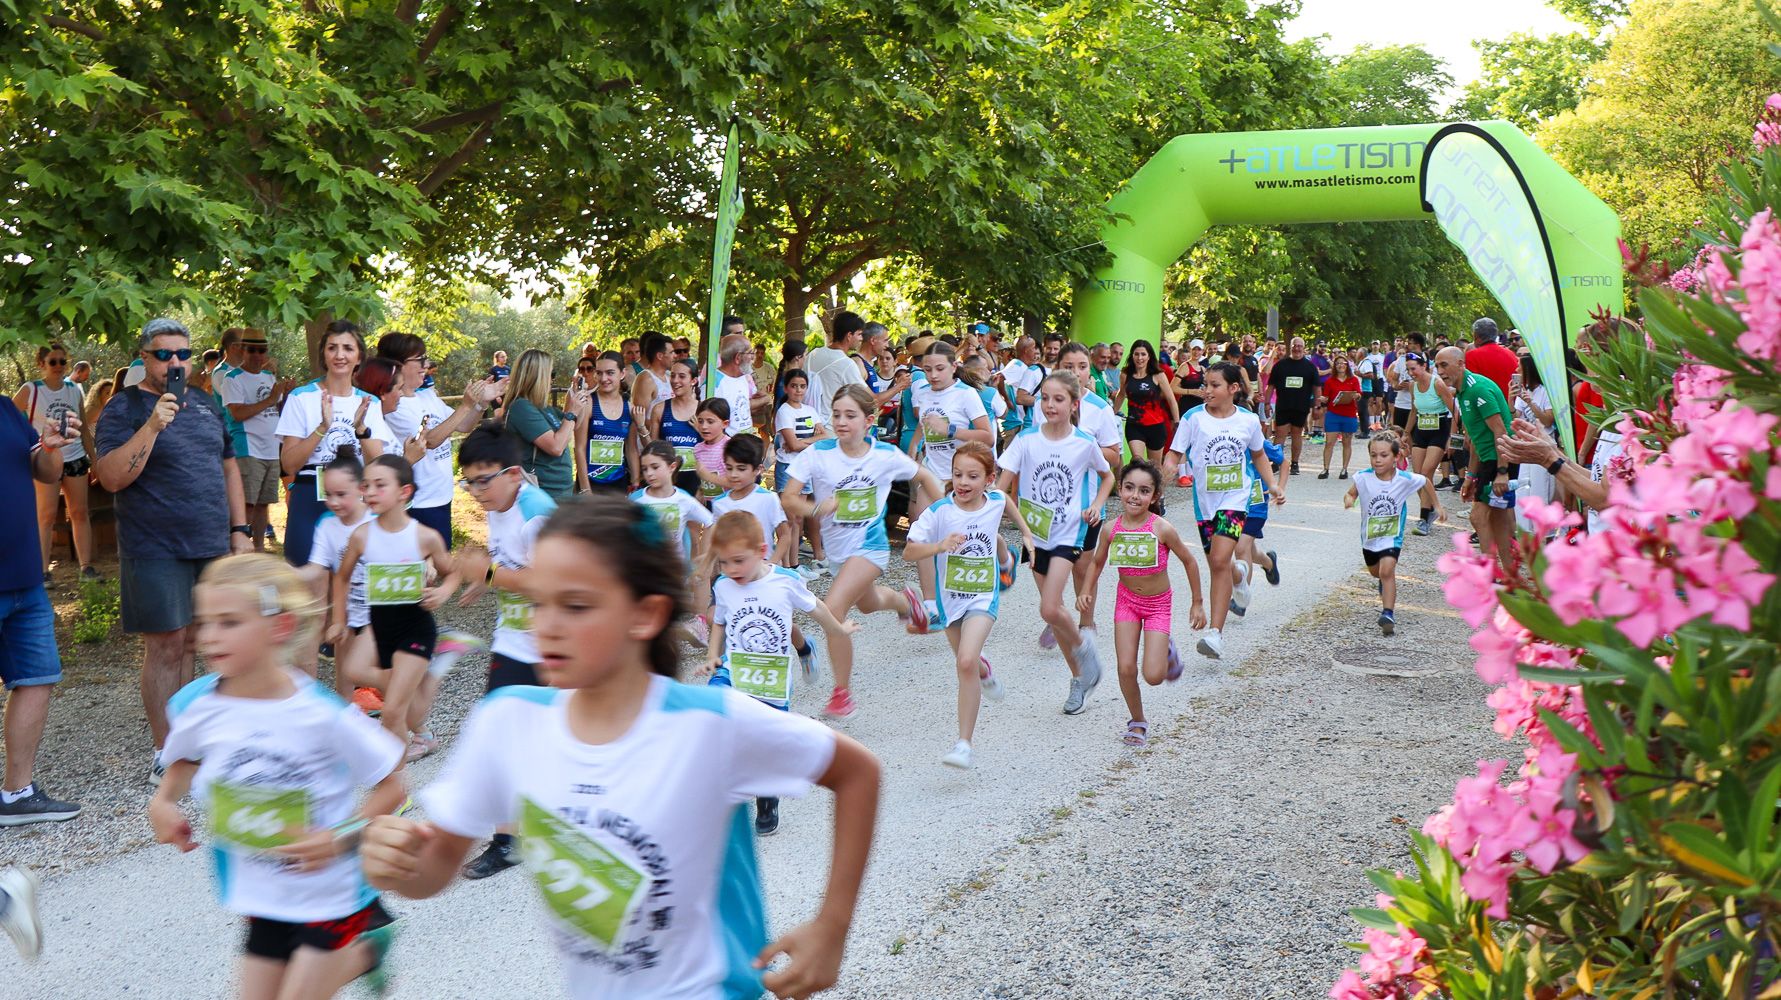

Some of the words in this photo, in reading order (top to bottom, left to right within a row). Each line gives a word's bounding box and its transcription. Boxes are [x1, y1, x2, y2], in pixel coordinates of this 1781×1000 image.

[1255, 174, 1415, 189] www.masatletismo.com
[600, 448, 615, 458] 24
[1032, 461, 1055, 482] CARRERA
[1213, 472, 1237, 484] 280
[848, 498, 869, 512] 65
[1026, 511, 1043, 527] 67
[1373, 522, 1394, 533] 257
[1116, 543, 1149, 557] 265
[953, 567, 989, 583] 262
[374, 575, 417, 592] 412
[757, 605, 788, 643] MEMORIAL
[738, 667, 779, 686] 263
[226, 805, 285, 837] 66
